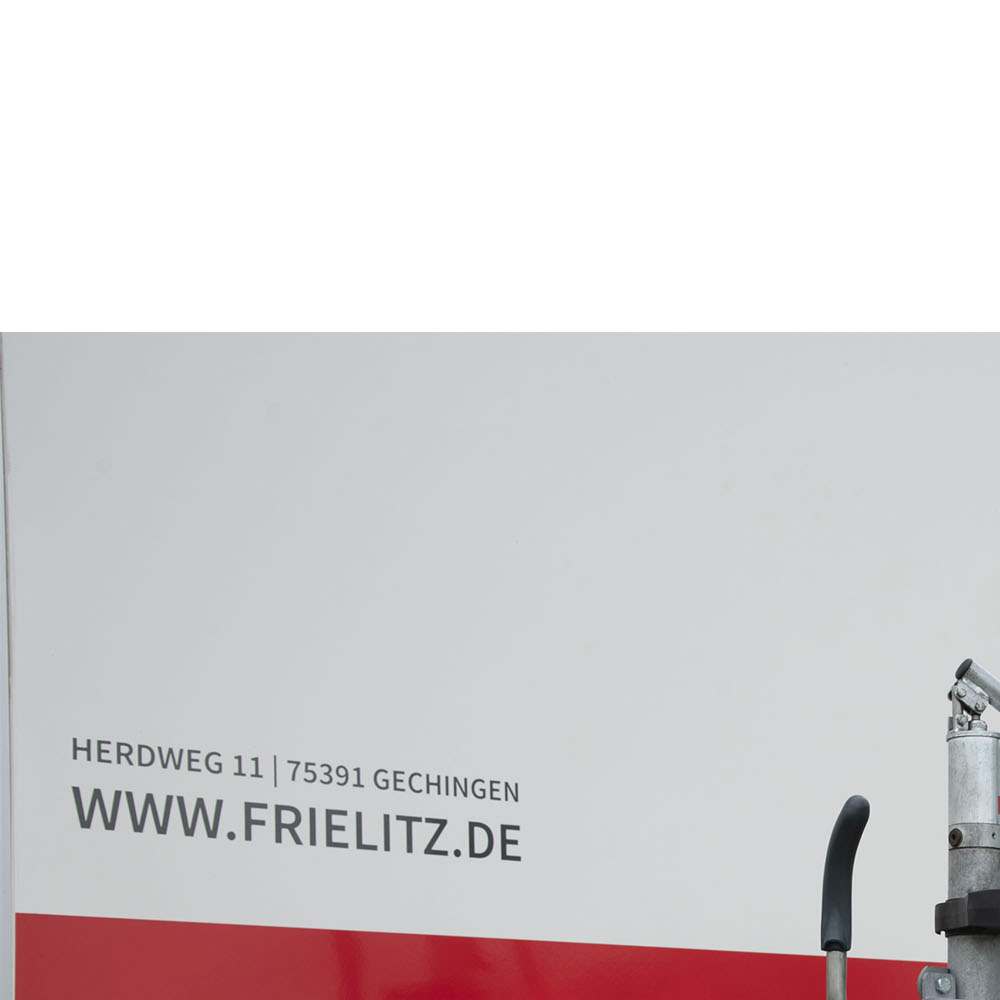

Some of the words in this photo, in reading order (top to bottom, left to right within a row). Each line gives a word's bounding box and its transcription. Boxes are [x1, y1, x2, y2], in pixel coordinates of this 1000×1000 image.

[71, 737, 223, 775] HERDWEG
[232, 755, 264, 779] 11
[286, 759, 366, 789] 75391
[373, 768, 520, 803] GECHINGEN
[71, 785, 522, 862] WWW.FRIELITZ.DE
